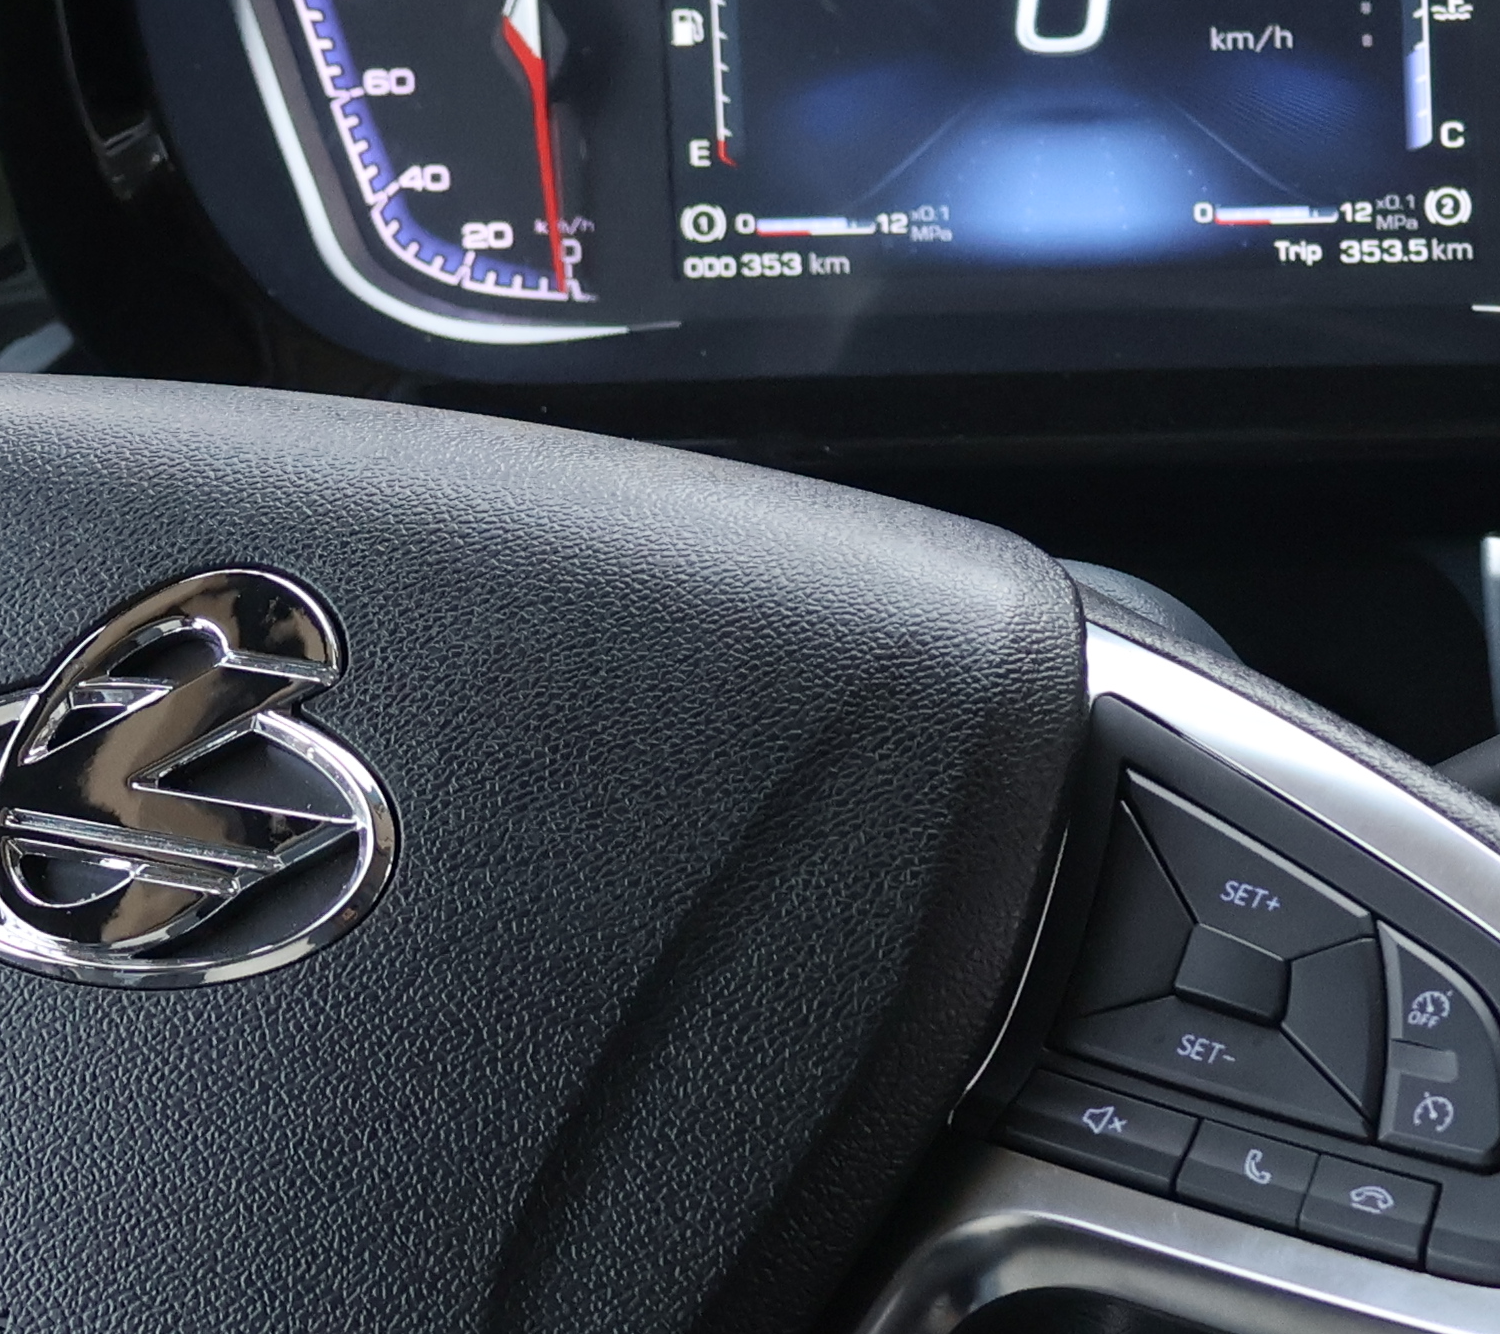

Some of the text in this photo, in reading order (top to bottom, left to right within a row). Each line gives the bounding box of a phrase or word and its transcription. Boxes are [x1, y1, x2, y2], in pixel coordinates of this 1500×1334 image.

[1210, 23, 1294, 53] km/h
[363, 69, 415, 96] 60
[1439, 121, 1465, 148] C
[690, 142, 710, 167] E
[398, 165, 451, 192] 40
[734, 213, 756, 235] 0
[876, 213, 909, 234] 12
[1193, 202, 1214, 224] 0
[1340, 201, 1372, 223] 12
[1376, 215, 1418, 231] MPa
[462, 223, 514, 250] 20
[911, 226, 952, 243] MPa
[740, 253, 802, 277] 353
[809, 253, 851, 276] km
[1274, 237, 1474, 266] Trip 353.5 km
[1219, 878, 1281, 913] SET+
[1407, 1009, 1439, 1029] OFF
[1175, 1033, 1236, 1065] SET-
